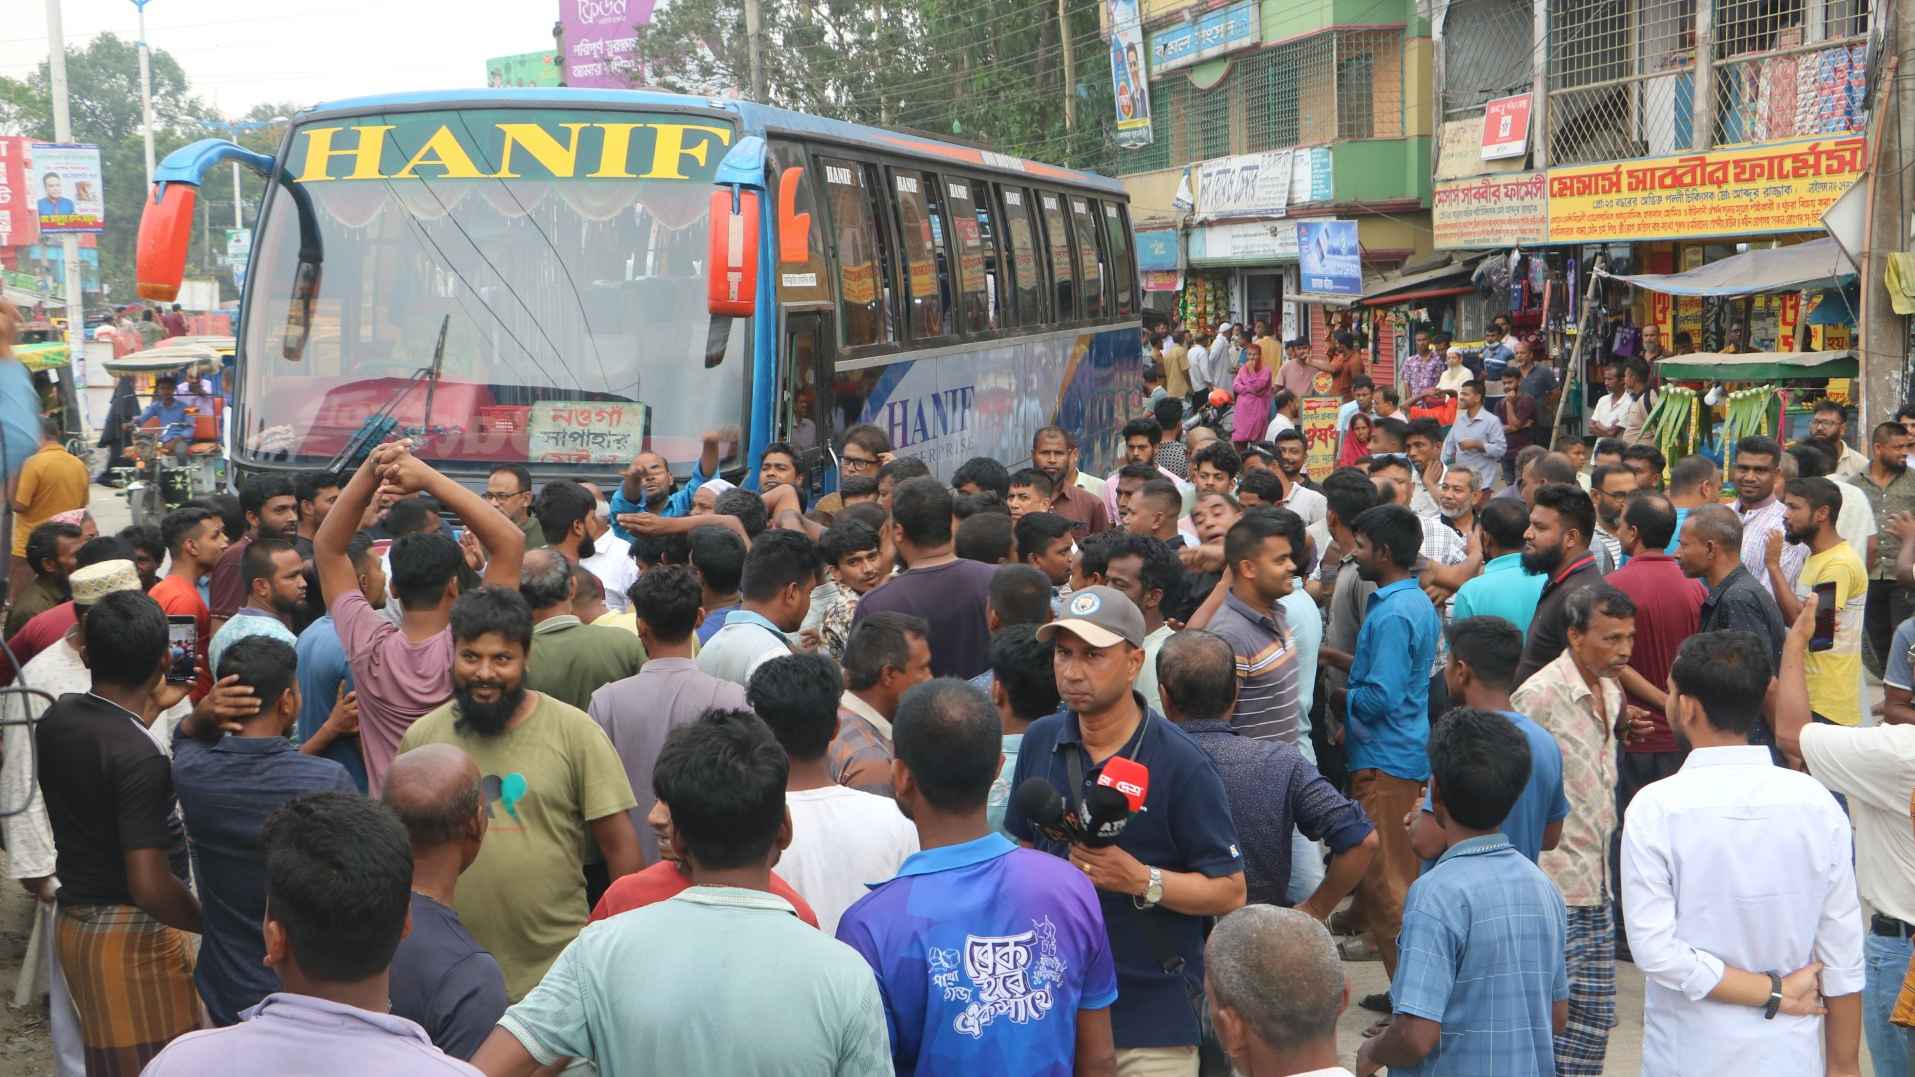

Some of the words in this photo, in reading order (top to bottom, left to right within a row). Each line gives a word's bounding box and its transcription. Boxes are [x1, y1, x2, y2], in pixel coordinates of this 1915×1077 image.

[293, 122, 730, 184] HANIF
[826, 165, 852, 185] HANIF
[896, 176, 918, 193] HANIF
[886, 385, 976, 450] HANIF
